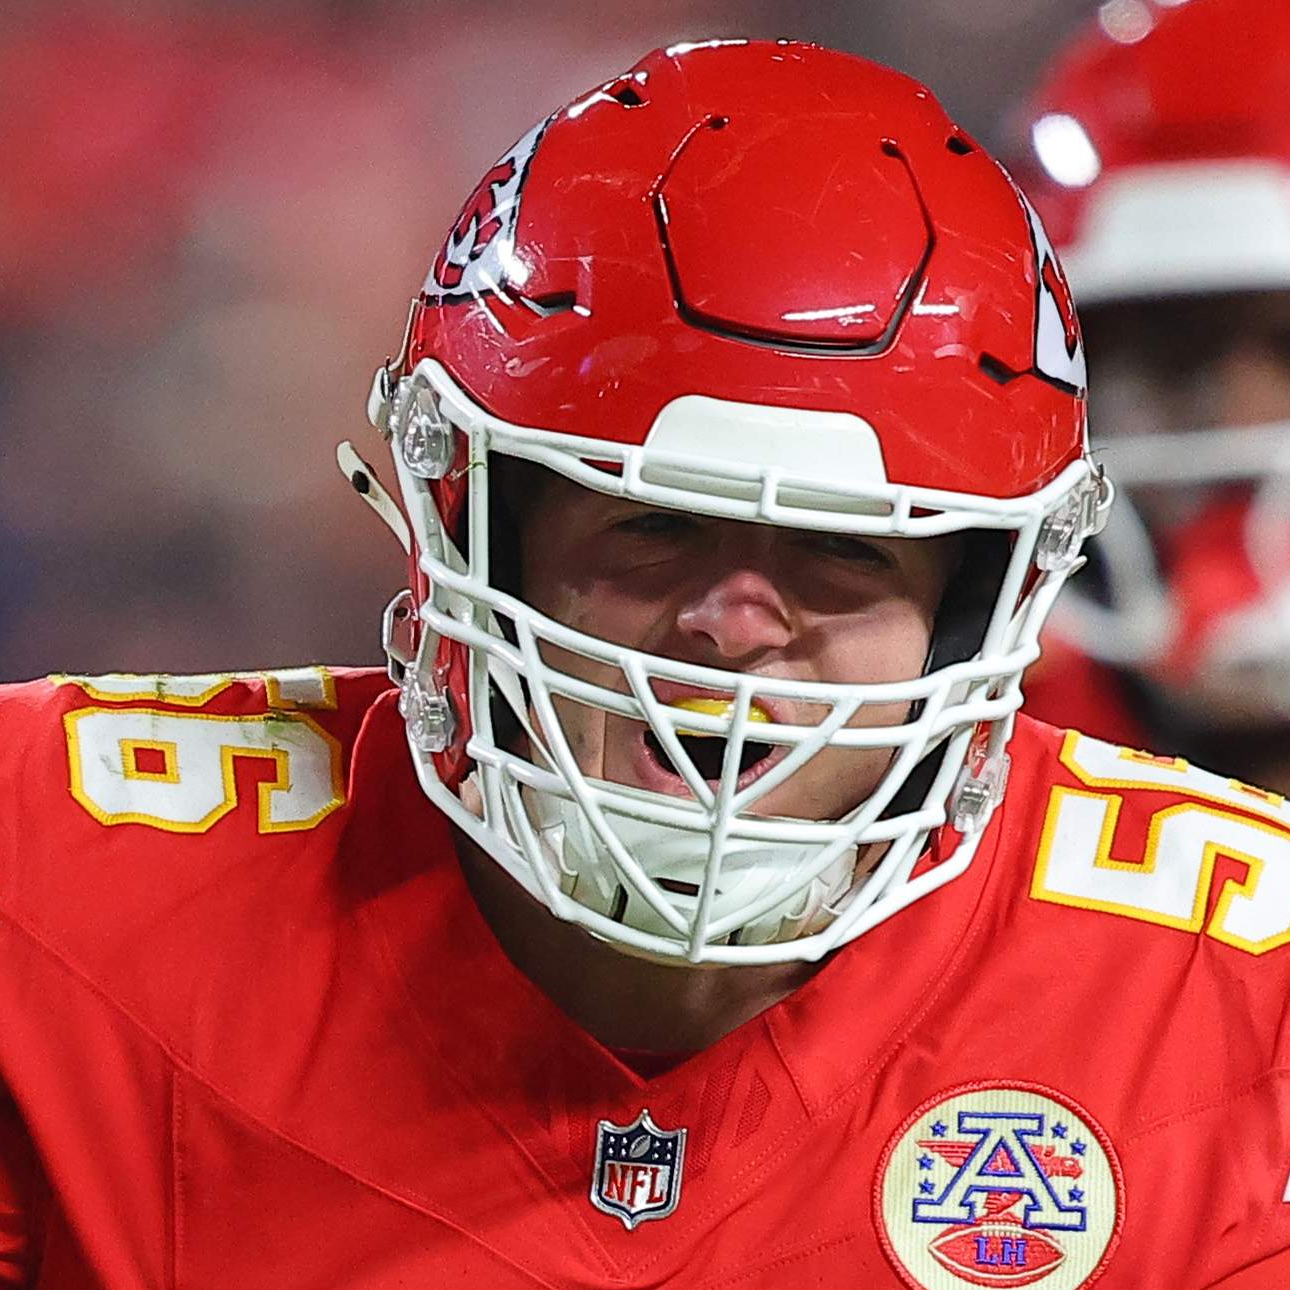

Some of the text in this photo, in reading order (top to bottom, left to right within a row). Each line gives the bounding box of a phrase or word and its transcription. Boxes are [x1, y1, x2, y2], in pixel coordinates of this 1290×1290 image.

[48, 667, 348, 834] 6
[604, 1162, 664, 1208] NFL
[912, 1111, 1087, 1232] A
[974, 1236, 1027, 1266] LH
